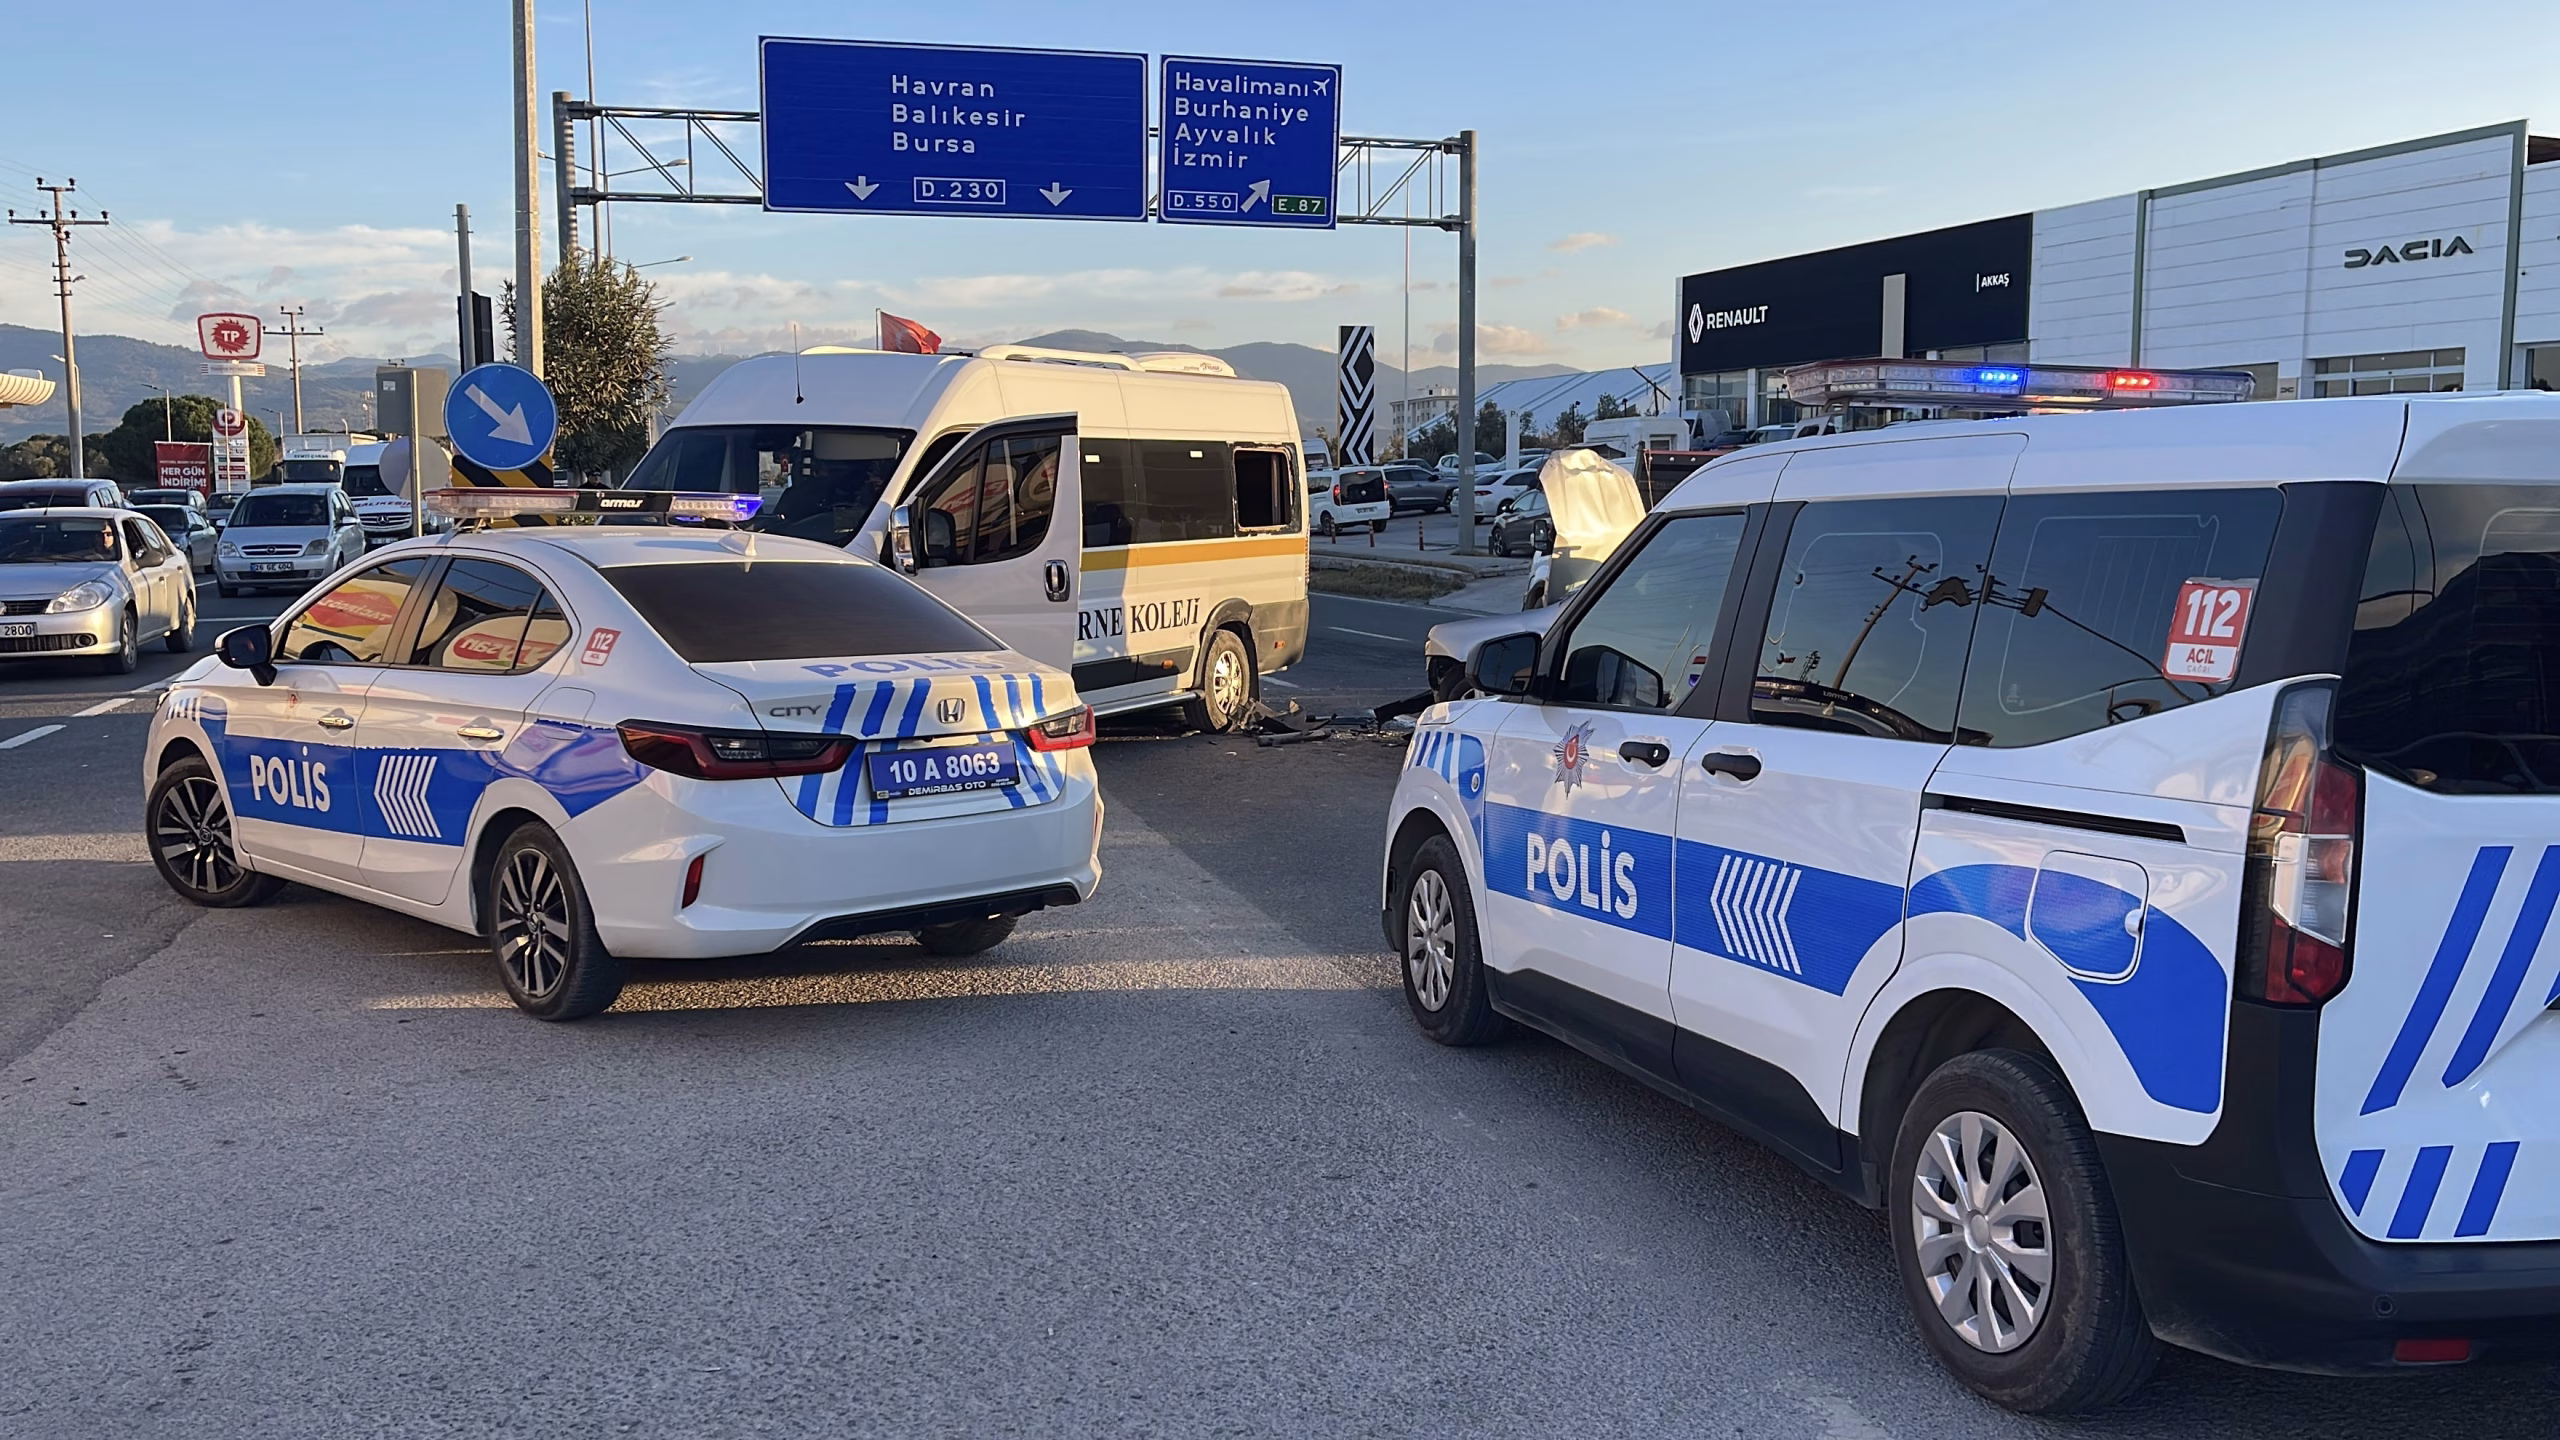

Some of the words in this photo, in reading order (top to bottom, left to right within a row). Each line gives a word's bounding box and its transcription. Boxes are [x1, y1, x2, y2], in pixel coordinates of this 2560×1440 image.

[891, 75, 995, 98] Havran
[1175, 71, 1309, 97] Havalimanı
[892, 103, 1026, 127] Balıkesir
[1175, 97, 1309, 126] Burhaniye
[893, 131, 976, 154] Bursa
[1175, 123, 1276, 146] Ayvalık
[1174, 143, 1248, 168] İzmir
[921, 181, 999, 199] D.230
[1174, 194, 1232, 209] D.550
[1278, 198, 1321, 212] E.87
[2343, 235, 2474, 269] DACIA
[1981, 273, 2010, 288] AKKAŞ
[1706, 305, 1768, 329] RENAULT
[221, 330, 240, 342] TP
[161, 467, 181, 476] HER
[182, 465, 205, 476] GÜN
[161, 475, 207, 487] İNDİRİM!
[600, 499, 644, 508] armas
[2184, 589, 2241, 638] 112
[4, 625, 32, 636] 2800
[591, 631, 614, 651] 112
[801, 655, 1004, 678] POLİS
[769, 704, 822, 717] CITY
[250, 745, 331, 813] POLİS
[889, 759, 917, 783] 10
[924, 758, 941, 781] A
[945, 752, 1000, 778] 8063
[964, 780, 987, 790] OTO
[1526, 829, 1638, 919] POLİS
